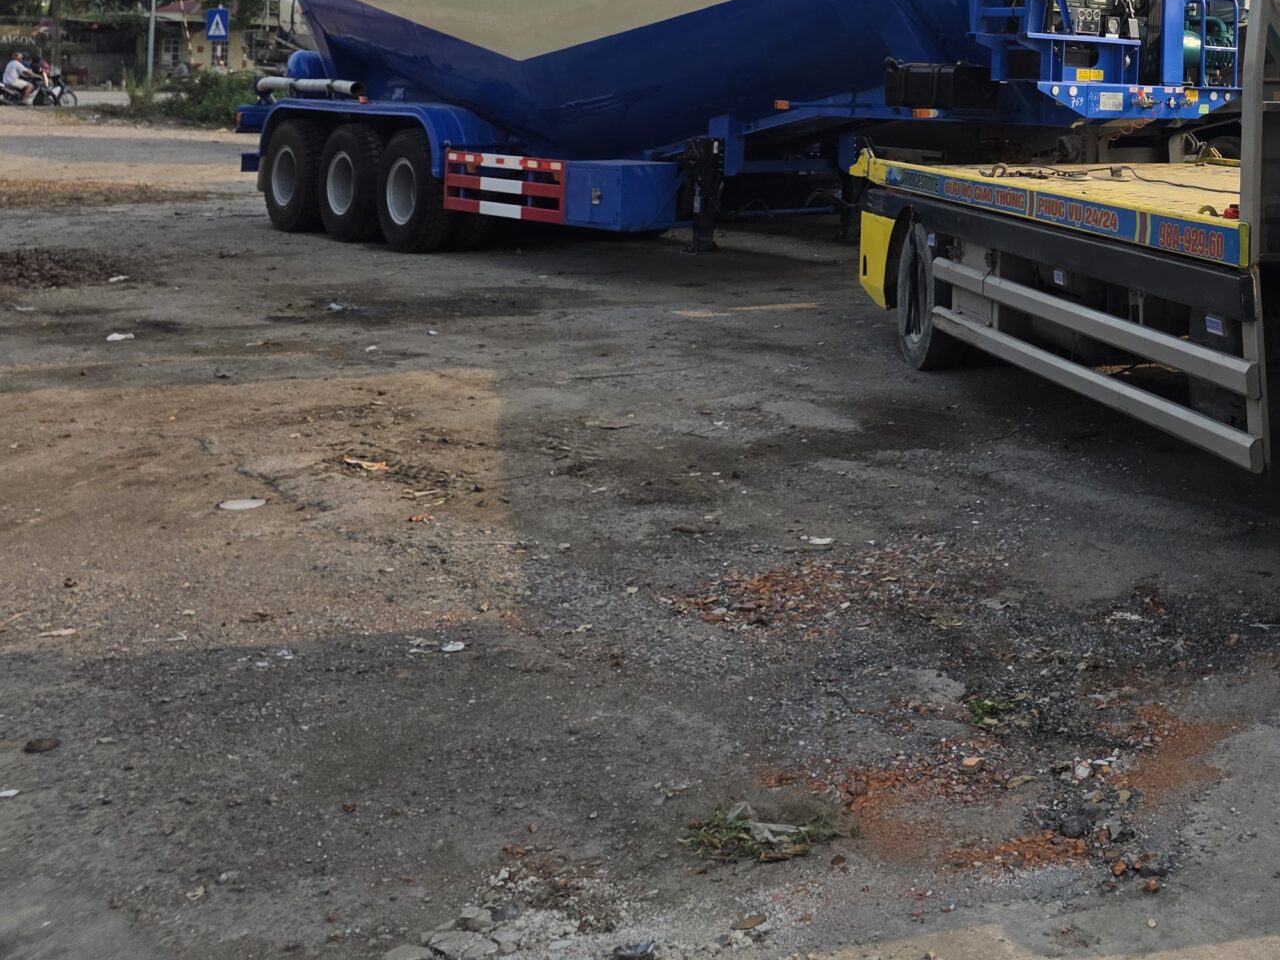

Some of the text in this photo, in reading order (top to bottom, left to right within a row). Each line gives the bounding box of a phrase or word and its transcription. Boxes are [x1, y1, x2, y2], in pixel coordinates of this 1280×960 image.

[974, 185, 994, 204] GIAO
[994, 187, 1026, 211] THÔNG
[1036, 195, 1119, 232] PHỤC VỤ 24/24
